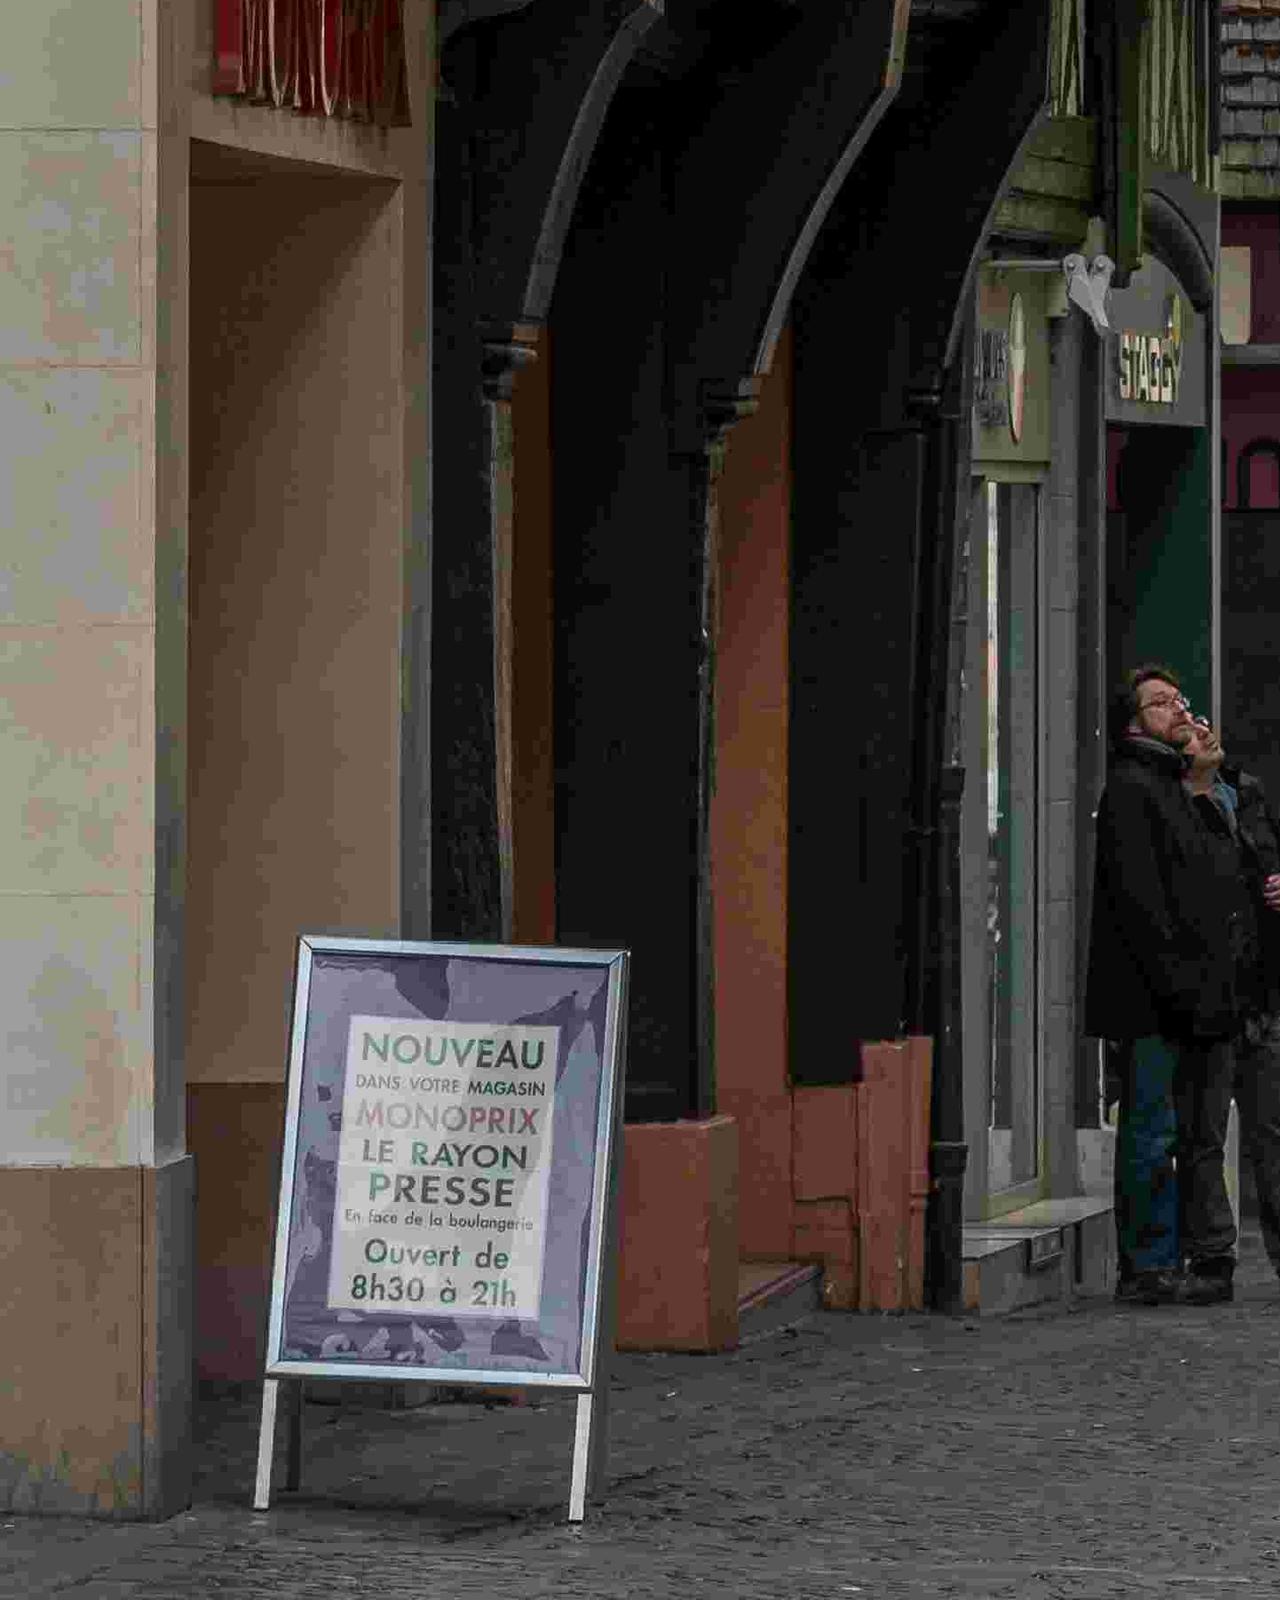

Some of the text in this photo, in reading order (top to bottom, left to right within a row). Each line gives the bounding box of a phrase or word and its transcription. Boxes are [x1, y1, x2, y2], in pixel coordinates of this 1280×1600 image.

[362, 1032, 545, 1069] NOUVEAU
[355, 1074, 545, 1096] DANS VOTRE MAGASIN
[355, 1099, 539, 1135] MONOPRIX
[362, 1139, 528, 1170] LE RAYON
[369, 1172, 515, 1207] PRESSE
[345, 1209, 533, 1233] En face de la boulangerie
[364, 1238, 509, 1269] Ouvert de
[351, 1272, 516, 1308] 8h30 à 21h
